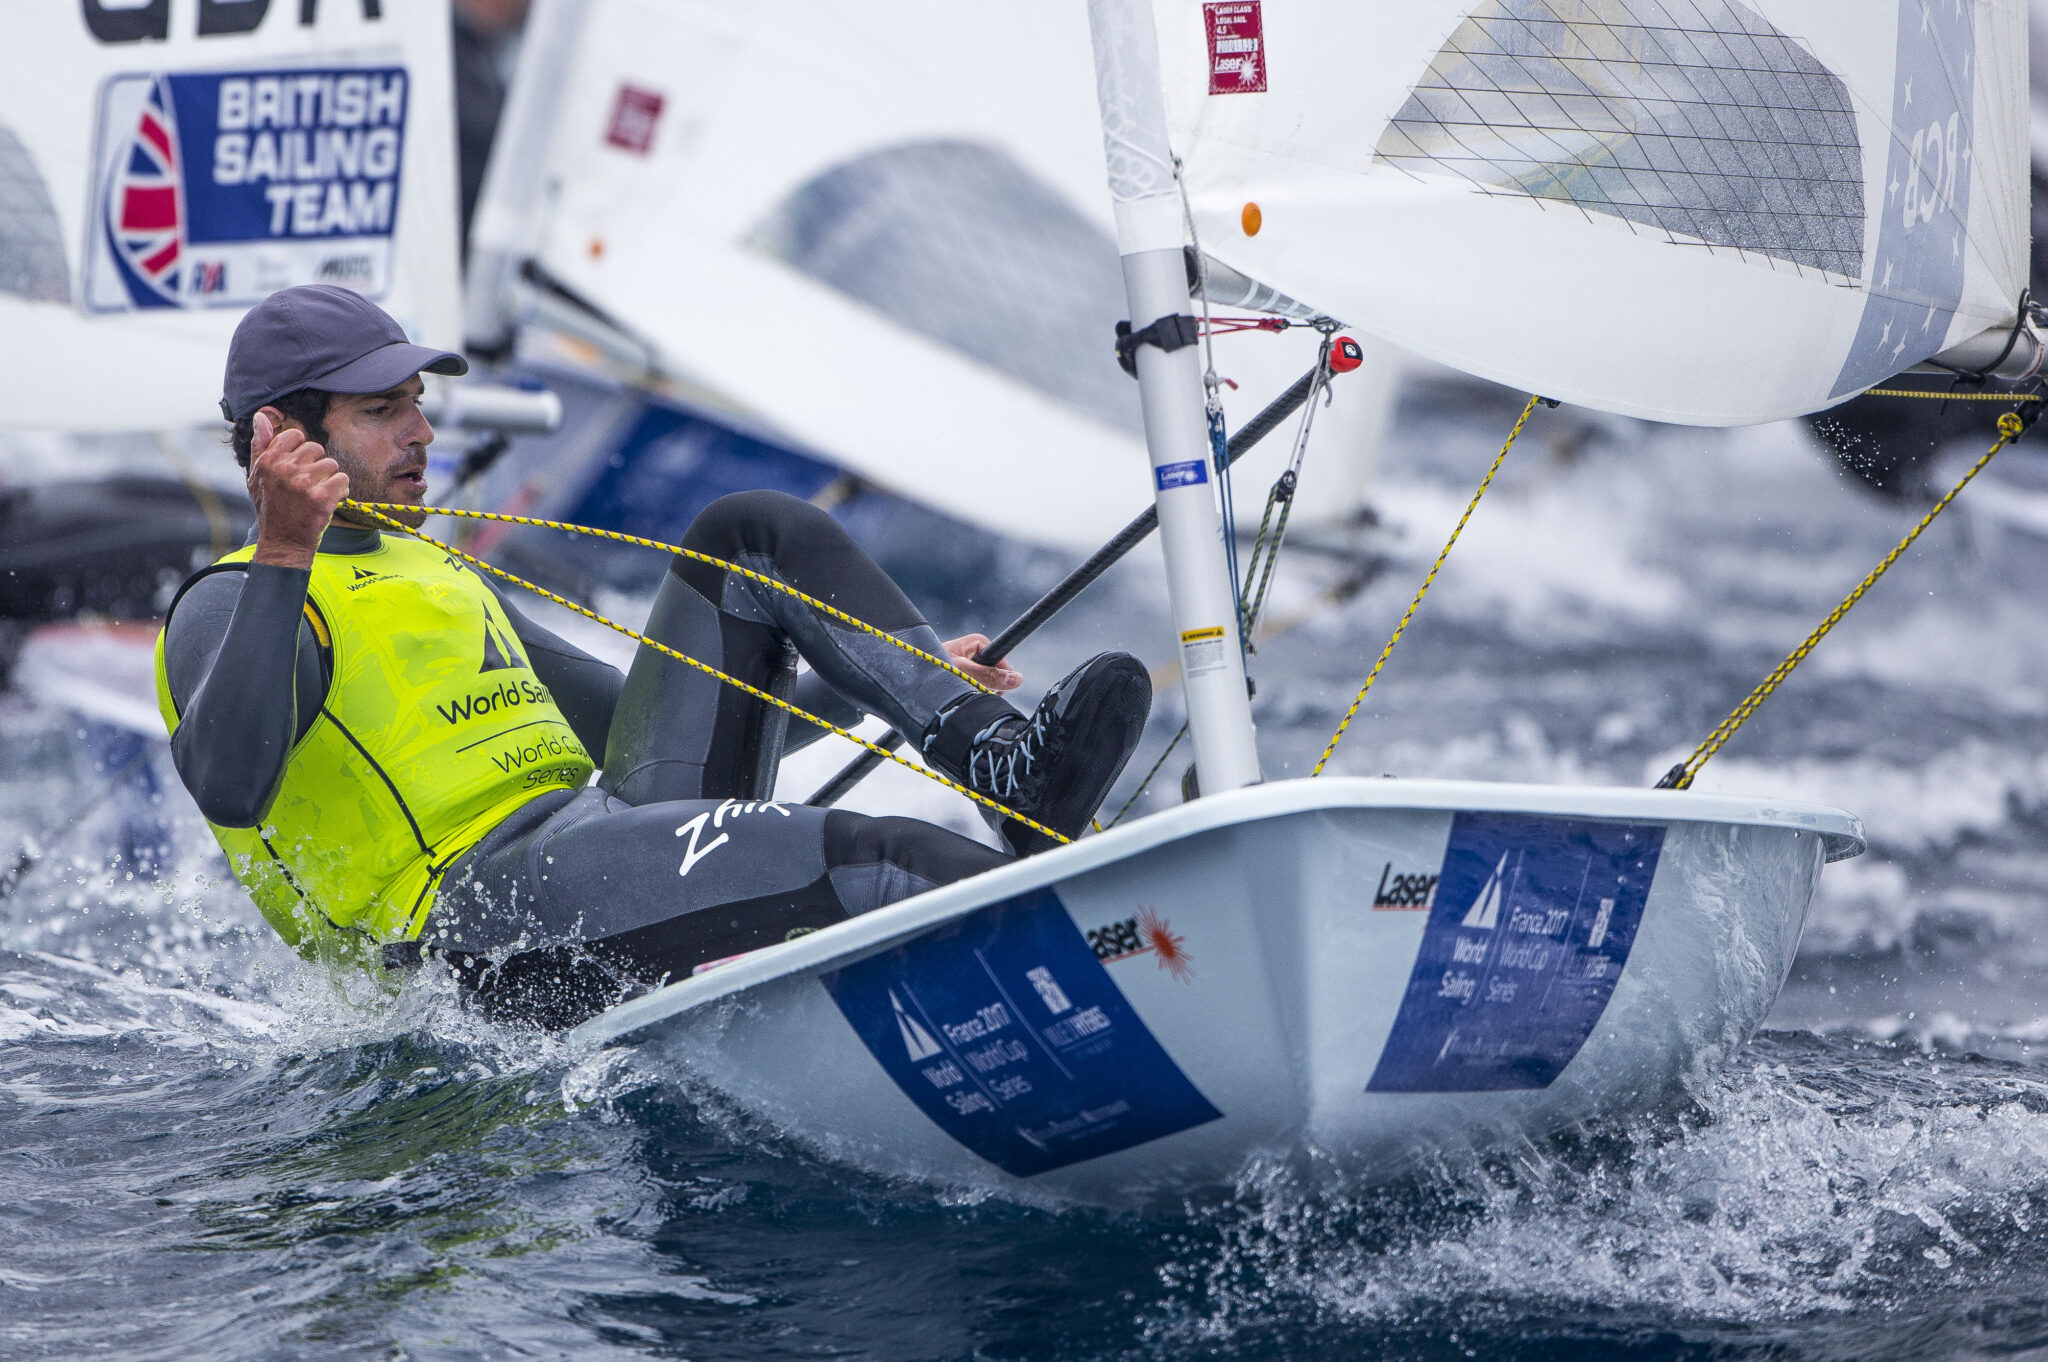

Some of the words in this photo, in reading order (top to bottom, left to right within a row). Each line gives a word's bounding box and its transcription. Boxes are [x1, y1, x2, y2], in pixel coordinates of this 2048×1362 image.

[1215, 56, 1243, 71] Laser
[216, 76, 402, 131] BRITISH
[212, 128, 399, 185] SAILING
[265, 181, 394, 237] TEAM
[346, 578, 376, 592] World
[436, 681, 521, 725] World
[491, 734, 562, 774] World
[1373, 861, 1440, 907] Laser
[1086, 917, 1143, 959] aser
[1453, 936, 1491, 965] World
[1437, 970, 1477, 1006] Sailing
[942, 1018, 988, 1046] France
